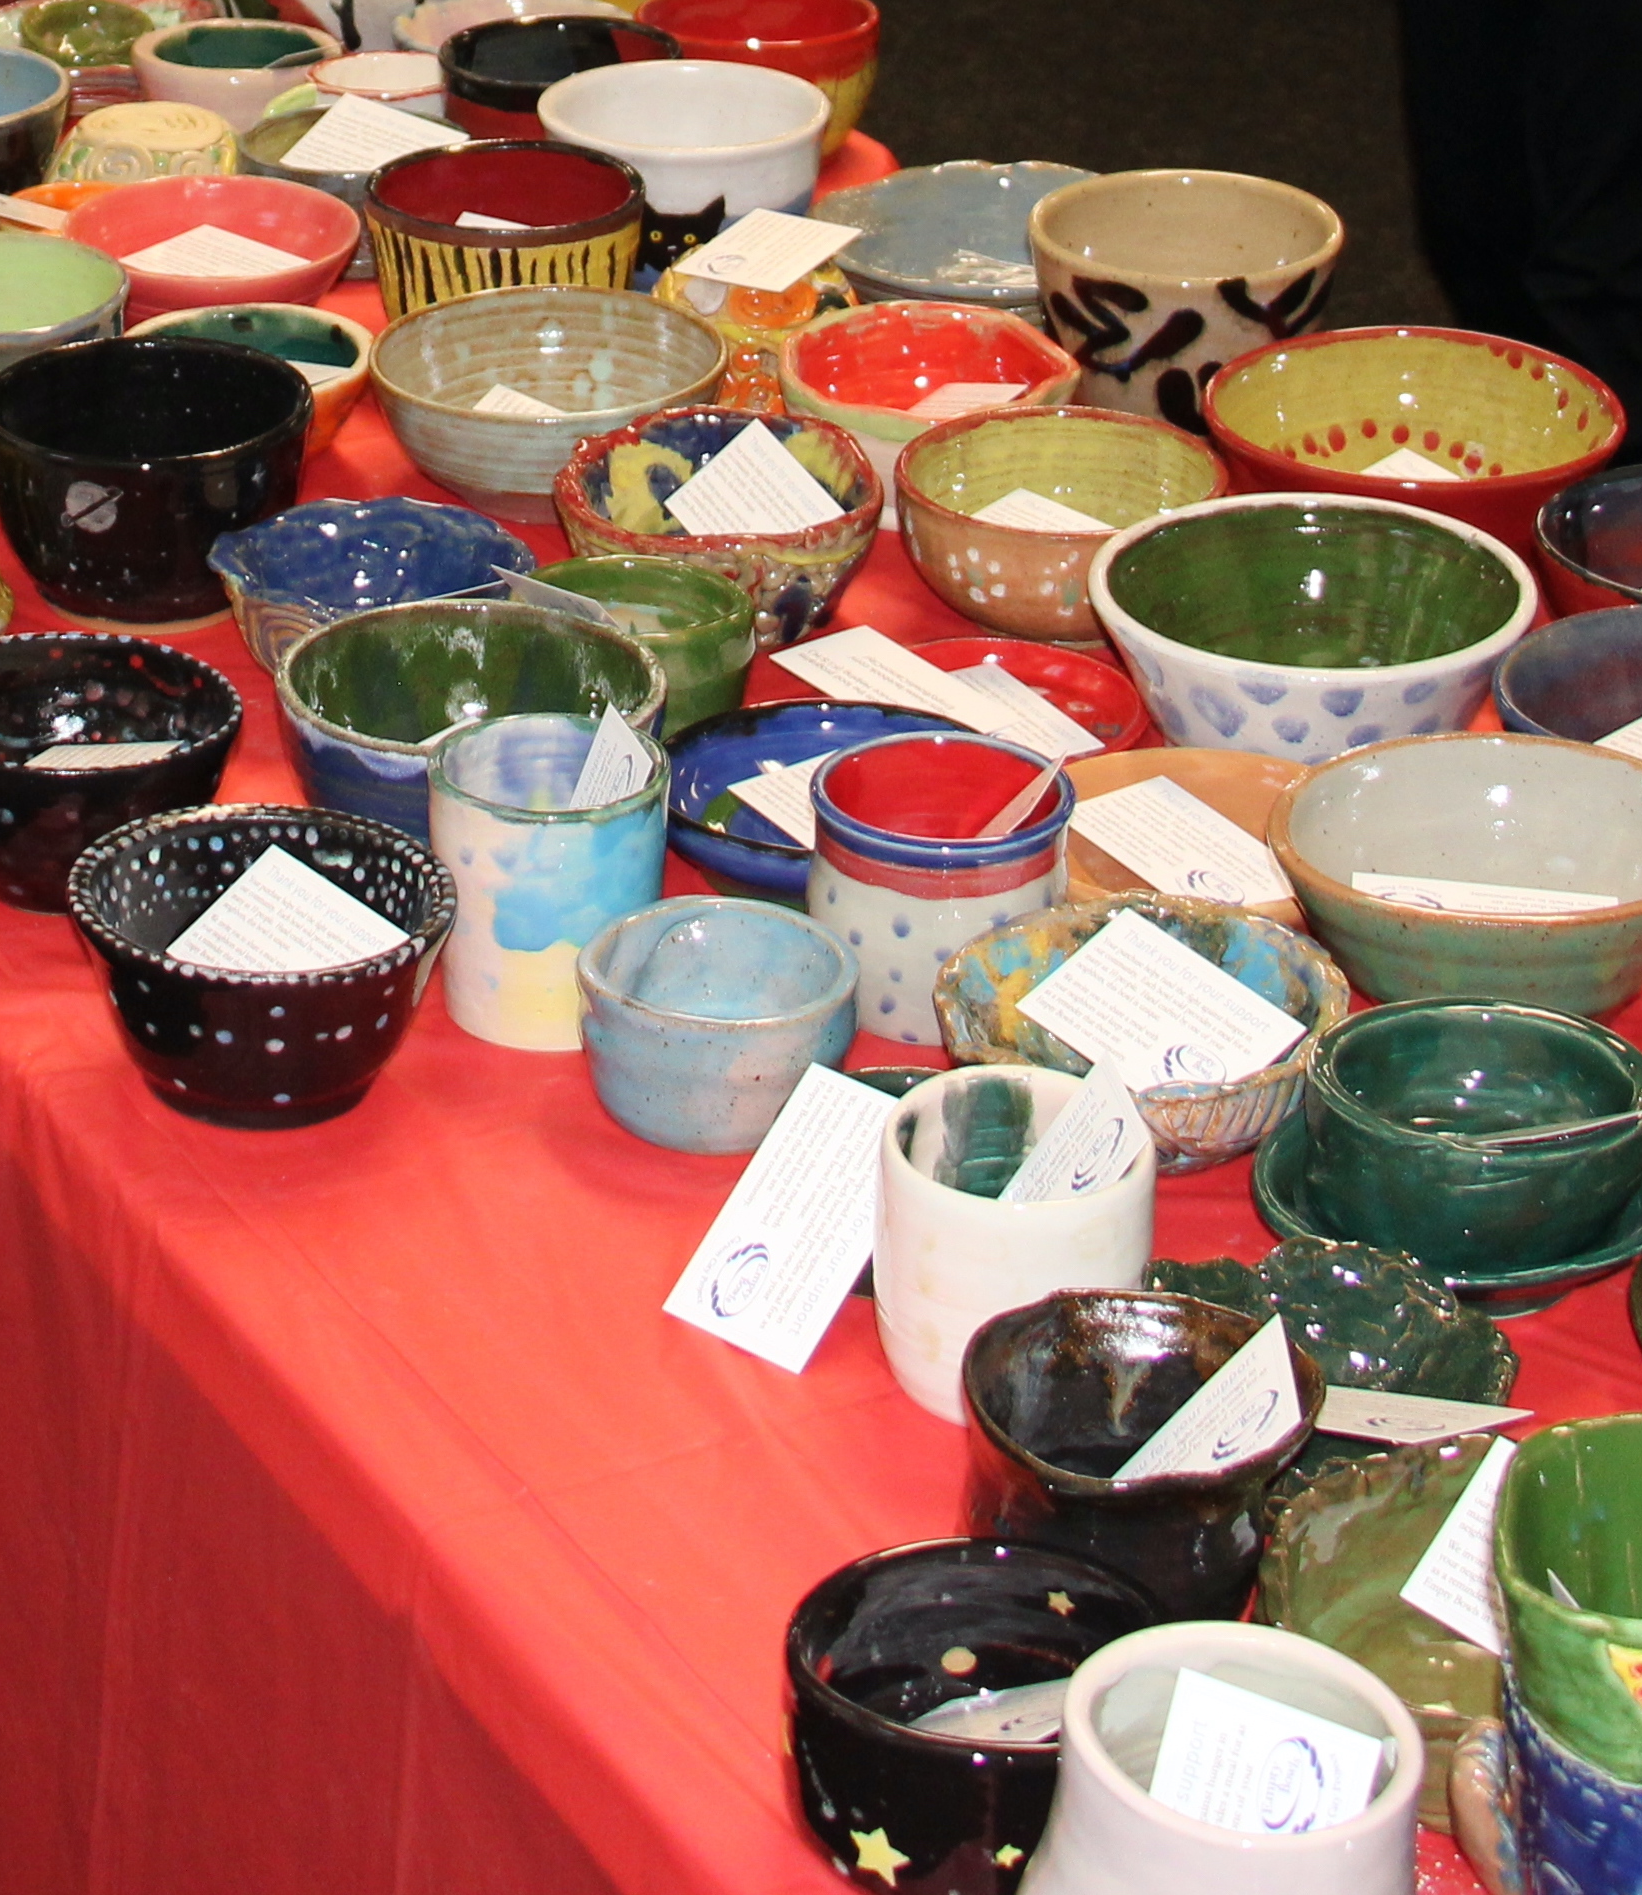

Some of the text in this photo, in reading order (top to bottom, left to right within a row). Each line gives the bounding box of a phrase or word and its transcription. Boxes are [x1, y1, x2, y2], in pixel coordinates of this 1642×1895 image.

[266, 863, 386, 950] Thank you for your support
[1123, 927, 1272, 1032] Thank you for your support
[1027, 1144, 1052, 1181] your
[1053, 1084, 1095, 1145] support
[846, 1212, 871, 1237] for
[738, 1261, 768, 1301] Empty
[824, 1237, 853, 1274] your
[723, 1274, 750, 1306] Bowls
[787, 1274, 831, 1337] support
[1130, 1348, 1257, 1479] ou for your support
[1175, 1716, 1209, 1803] support
[1259, 1760, 1285, 1817] Empty
[1276, 1753, 1303, 1796] Bowls
